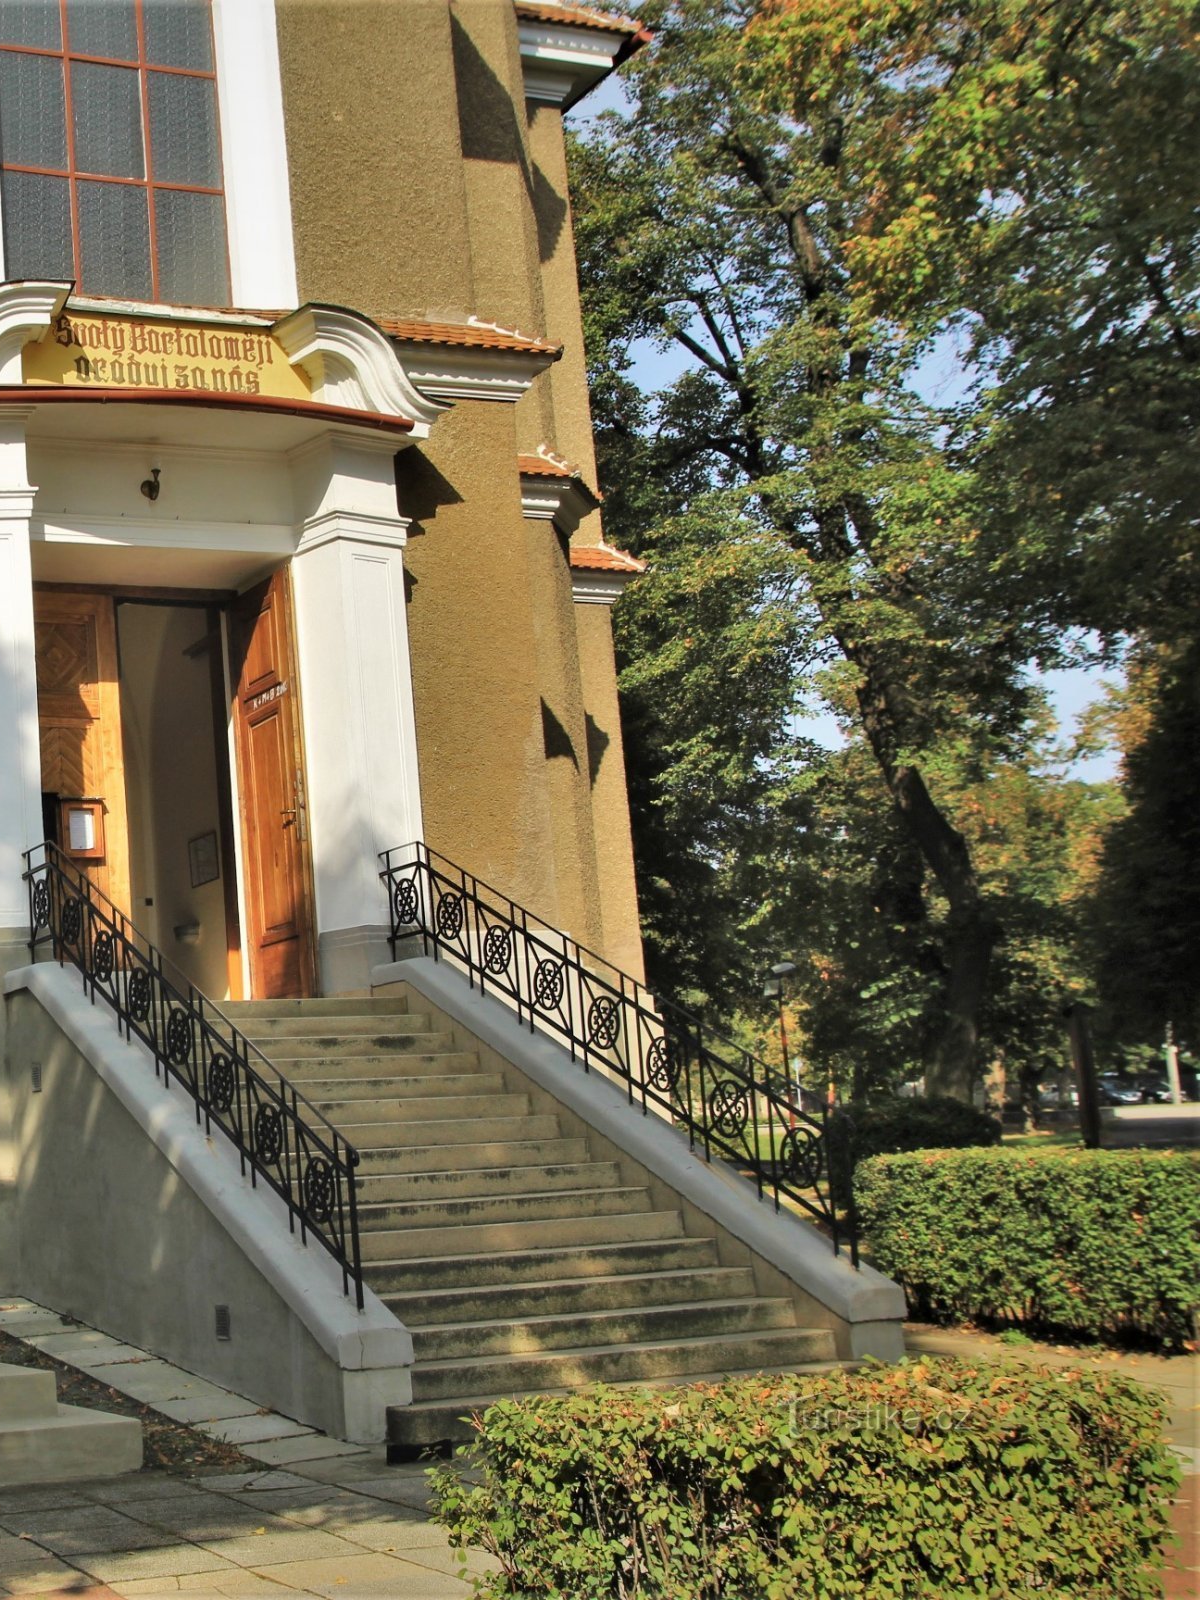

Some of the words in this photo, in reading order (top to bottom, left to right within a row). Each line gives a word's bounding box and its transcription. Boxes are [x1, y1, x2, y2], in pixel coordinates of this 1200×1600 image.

[54, 314, 125, 357] Svatý
[129, 322, 273, 369] Bartoloměji
[74, 354, 168, 388] oroduj
[174, 364, 209, 391] za
[211, 364, 261, 394] nás
